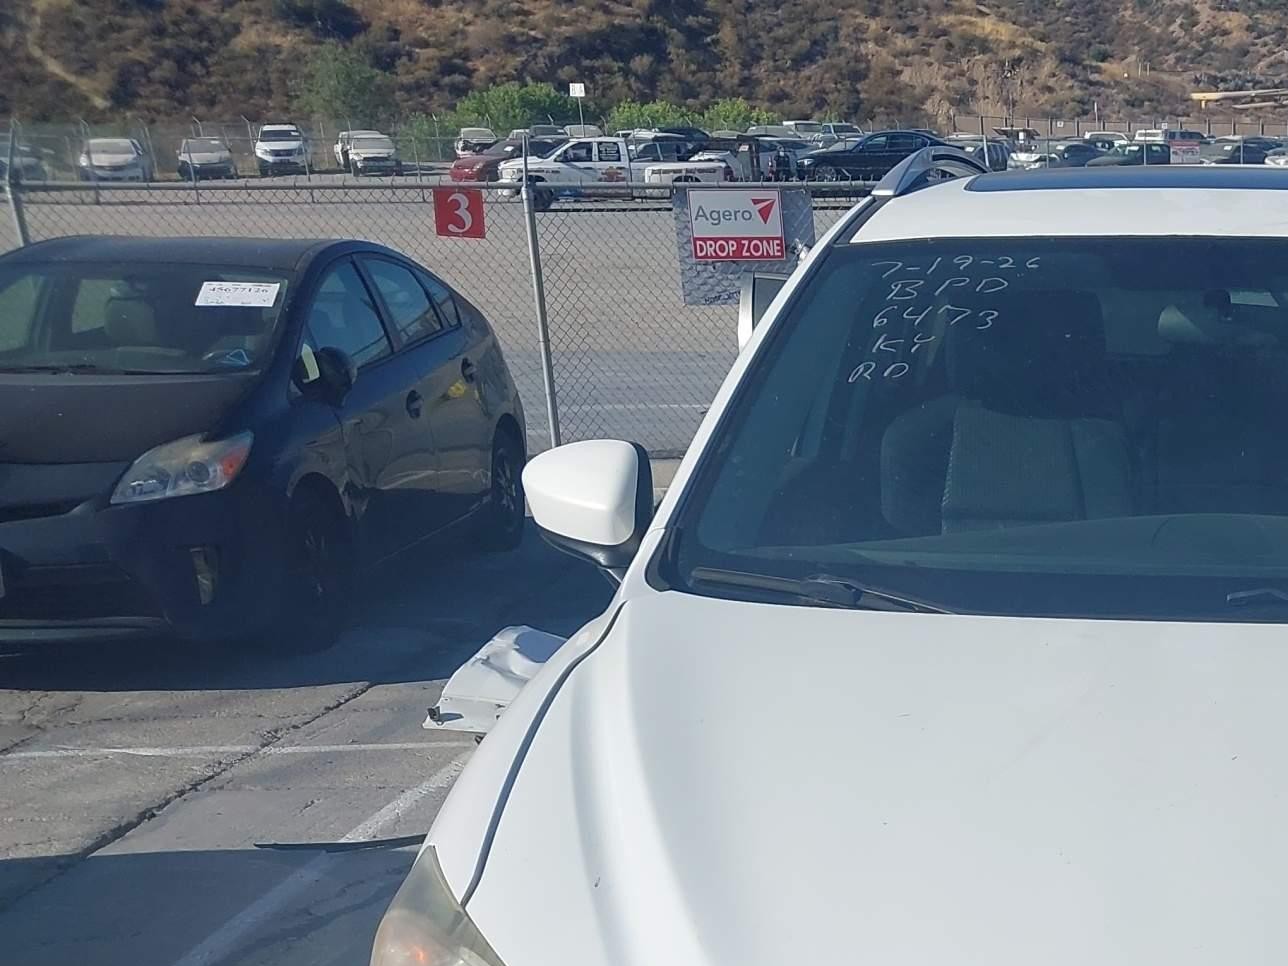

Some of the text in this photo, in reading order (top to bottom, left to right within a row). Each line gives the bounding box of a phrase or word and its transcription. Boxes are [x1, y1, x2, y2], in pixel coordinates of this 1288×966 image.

[447, 193, 473, 233] 3
[695, 205, 752, 226] Agero
[696, 240, 782, 257] DROP ZONE
[886, 277, 1009, 300] BPD
[873, 304, 999, 329] 6473
